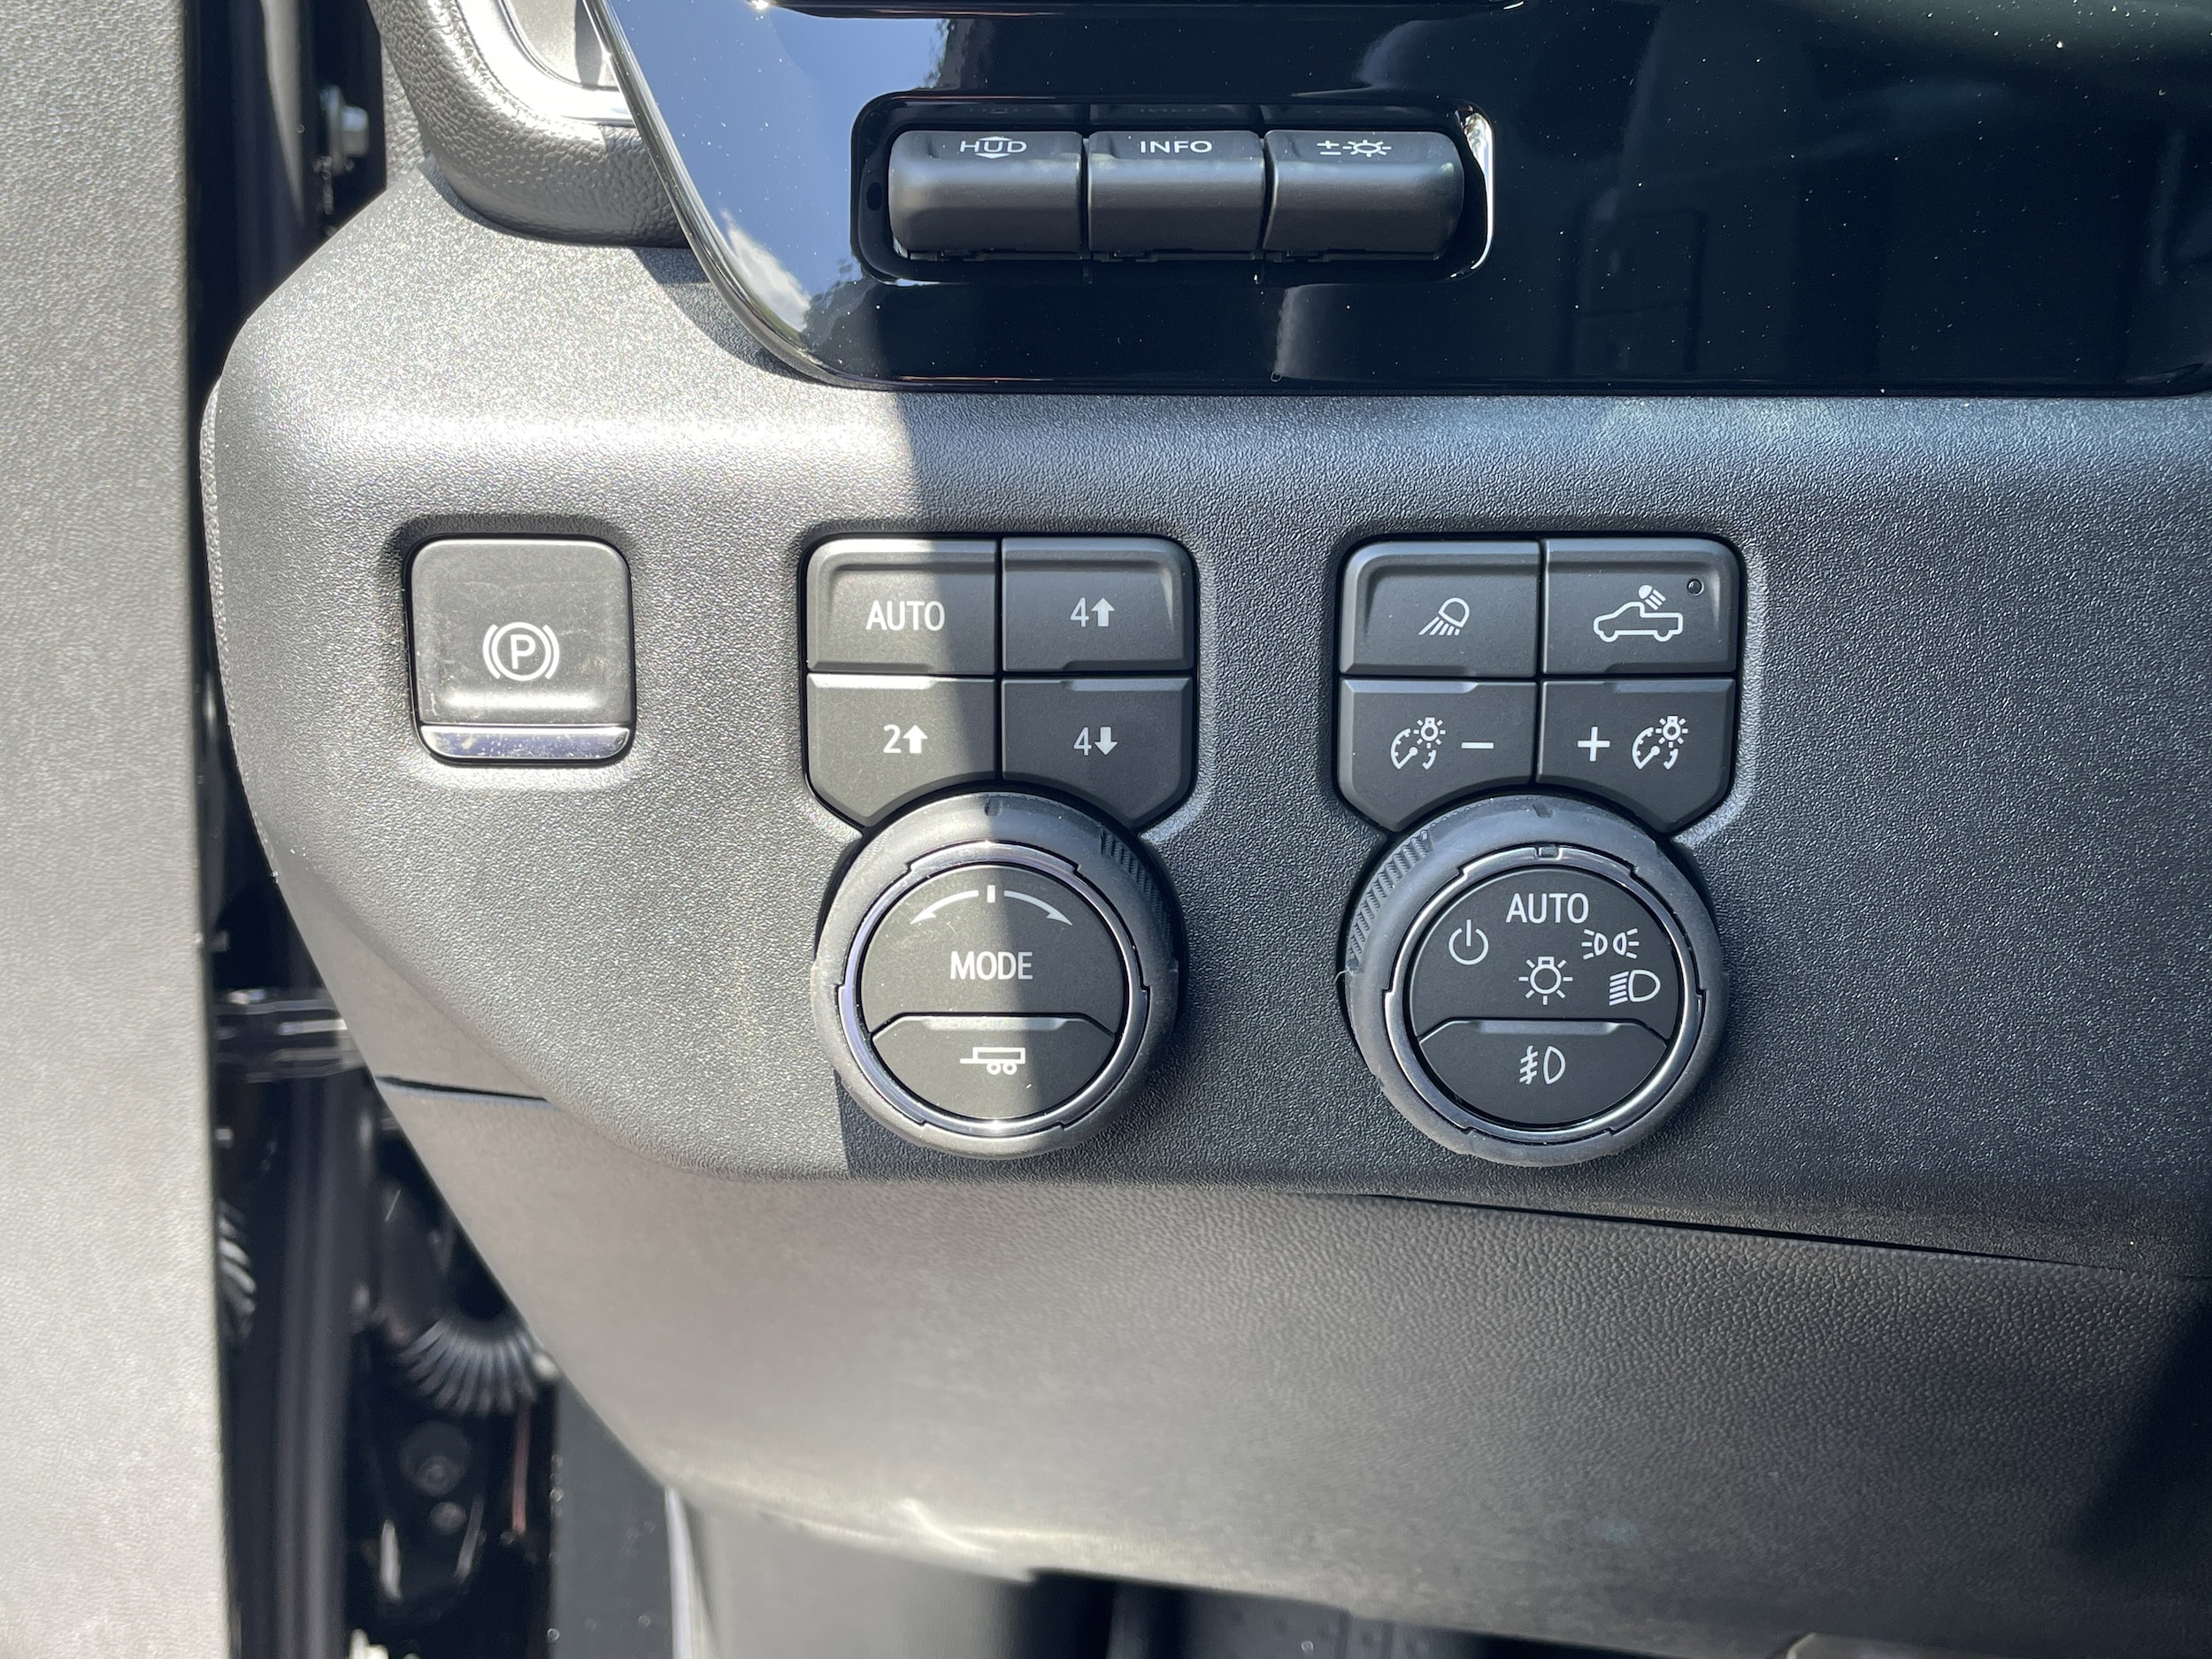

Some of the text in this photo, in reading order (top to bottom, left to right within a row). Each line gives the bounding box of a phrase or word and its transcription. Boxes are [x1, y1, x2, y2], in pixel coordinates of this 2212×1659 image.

[959, 139, 1027, 154] HUD
[1140, 140, 1213, 154] INFO
[865, 600, 946, 631] AUTO
[1070, 597, 1089, 627] 4
[510, 634, 536, 670] P
[883, 725, 902, 754] 2
[1073, 726, 1093, 756] 4
[1505, 892, 1590, 924] AUTO
[949, 950, 1033, 980] MODE
